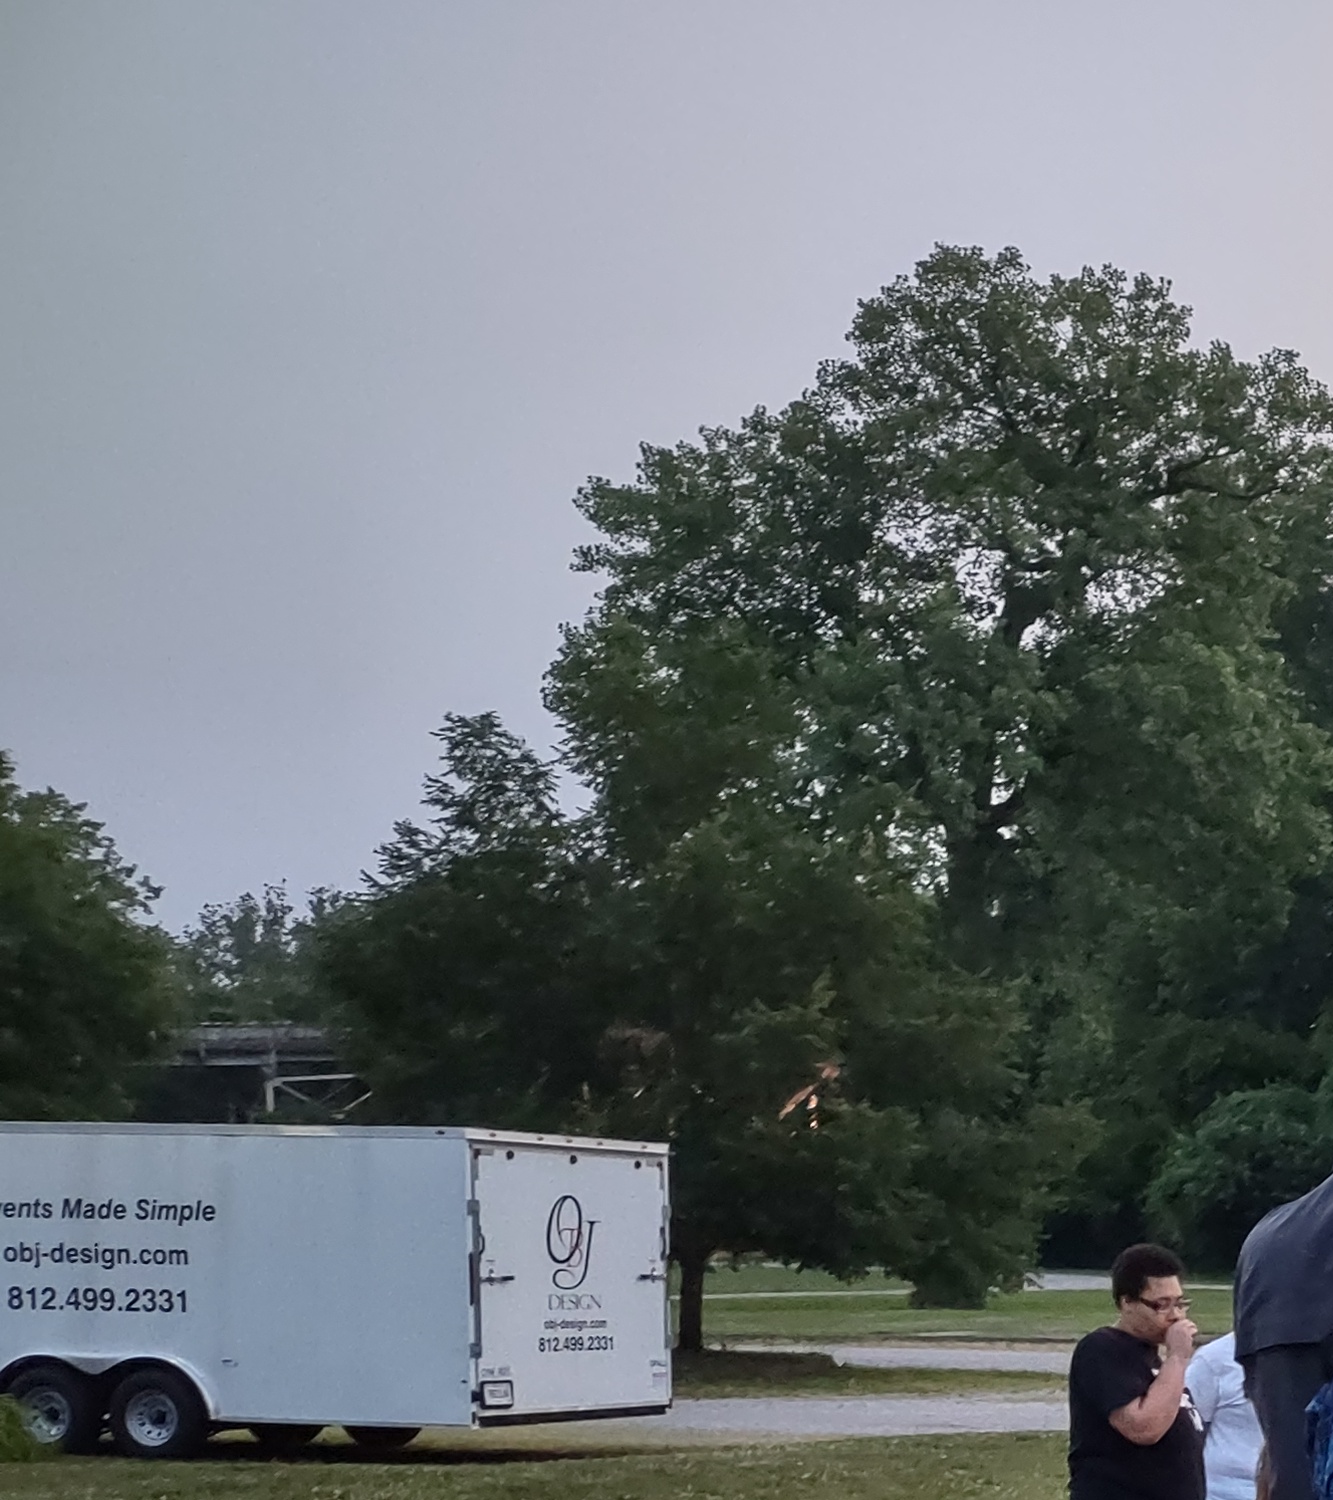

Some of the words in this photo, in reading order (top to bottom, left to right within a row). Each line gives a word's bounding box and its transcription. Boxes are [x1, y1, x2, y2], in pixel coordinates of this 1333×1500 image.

[61, 1198, 128, 1220] Made
[135, 1199, 216, 1227] Simple
[3, 1242, 189, 1270] obj-design.com
[7, 1286, 188, 1313] 812.499.2331
[548, 1294, 602, 1311] DESIGN
[538, 1336, 614, 1352] 812.499.2331
